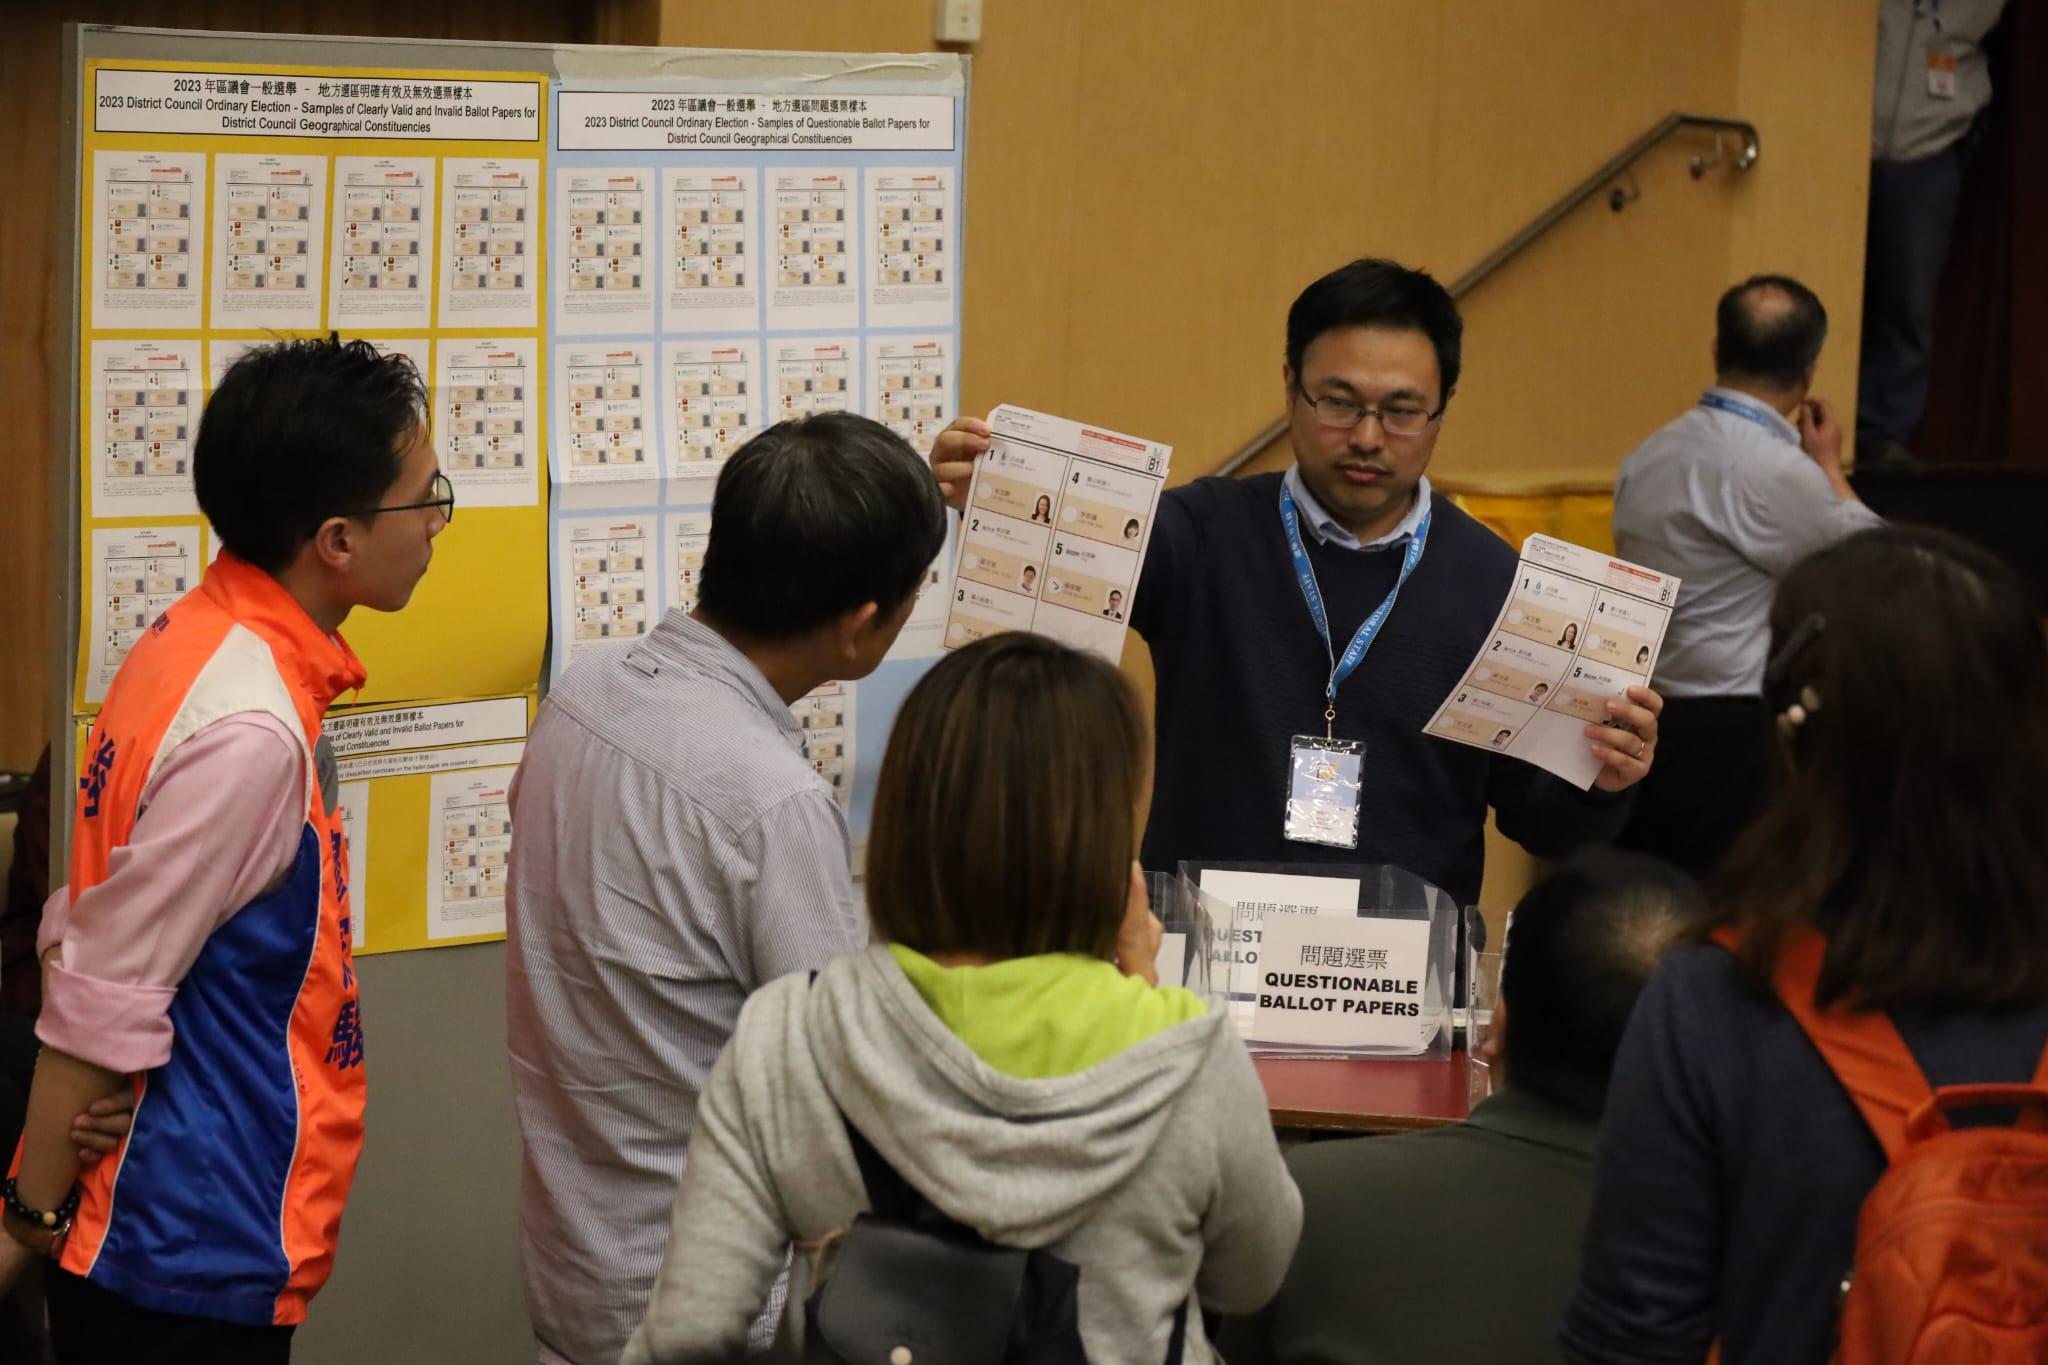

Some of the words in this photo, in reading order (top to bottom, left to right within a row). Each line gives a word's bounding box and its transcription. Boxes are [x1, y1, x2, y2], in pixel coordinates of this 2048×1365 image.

[174, 79, 201, 92] 2023
[205, 78, 297, 96] 年區議會一般選舉
[318, 82, 473, 100] 地方選區明確有效及無效選票樣本
[99, 96, 124, 108] 2023
[127, 97, 162, 109] District
[164, 98, 203, 111] Council
[205, 99, 249, 114] Ordinary
[251, 100, 291, 113] Election
[301, 102, 344, 116] Samples
[346, 103, 355, 115] of
[357, 104, 388, 118] Clearly
[391, 104, 413, 116] Valid
[416, 105, 431, 116] and
[434, 105, 463, 117] Invalid
[465, 106, 490, 118] Ballot
[492, 107, 522, 120] Papers
[524, 107, 536, 118] for
[651, 99, 675, 111] 2023
[678, 98, 756, 113] 年區議會一般選舉
[772, 99, 868, 113] 地方選區問題選票樣本
[222, 116, 256, 129] District
[259, 117, 296, 130] Council
[299, 119, 362, 134] Geographical
[364, 120, 431, 133] Constituencies
[585, 116, 607, 128] 2023
[609, 117, 639, 128] District
[641, 117, 674, 128] Council
[676, 117, 712, 130] Ordinary
[715, 117, 749, 128] Election
[757, 117, 794, 130] Samples
[796, 117, 804, 128] of
[806, 117, 860, 129] Questionable
[863, 117, 886, 128] Ballot
[888, 118, 917, 131] Papers
[919, 118, 930, 128] for
[667, 132, 697, 144] District
[699, 133, 731, 144] Council
[733, 132, 790, 146] Geographical
[792, 132, 853, 144] Constituencies
[988, 449, 995, 461] 1
[1147, 457, 1160, 472] B1
[1071, 471, 1080, 485] 4
[971, 519, 980, 532] 2
[1055, 542, 1063, 556] 5
[1523, 578, 1530, 590] 1
[957, 589, 965, 602] 3
[1661, 589, 1671, 602] B1
[1598, 601, 1605, 614] 4
[1344, 637, 1365, 666] STAFF
[1492, 640, 1502, 652] 2
[1573, 666, 1582, 678] 5
[1457, 693, 1467, 703] 3
[335, 733, 342, 742] of
[343, 731, 362, 741] Clearly
[364, 729, 378, 737] Valid
[380, 727, 391, 735] and
[393, 725, 412, 734] Invalid
[414, 723, 432, 732] Ballot
[433, 721, 454, 731] Papers
[456, 720, 464, 728] for
[347, 738, 390, 751] Constituencies
[1300, 944, 1389, 971] 問題選票
[1265, 972, 1419, 995] QUESTIONABLE
[1260, 994, 1337, 1012] BALLOT
[1342, 999, 1420, 1017] PAPERS
